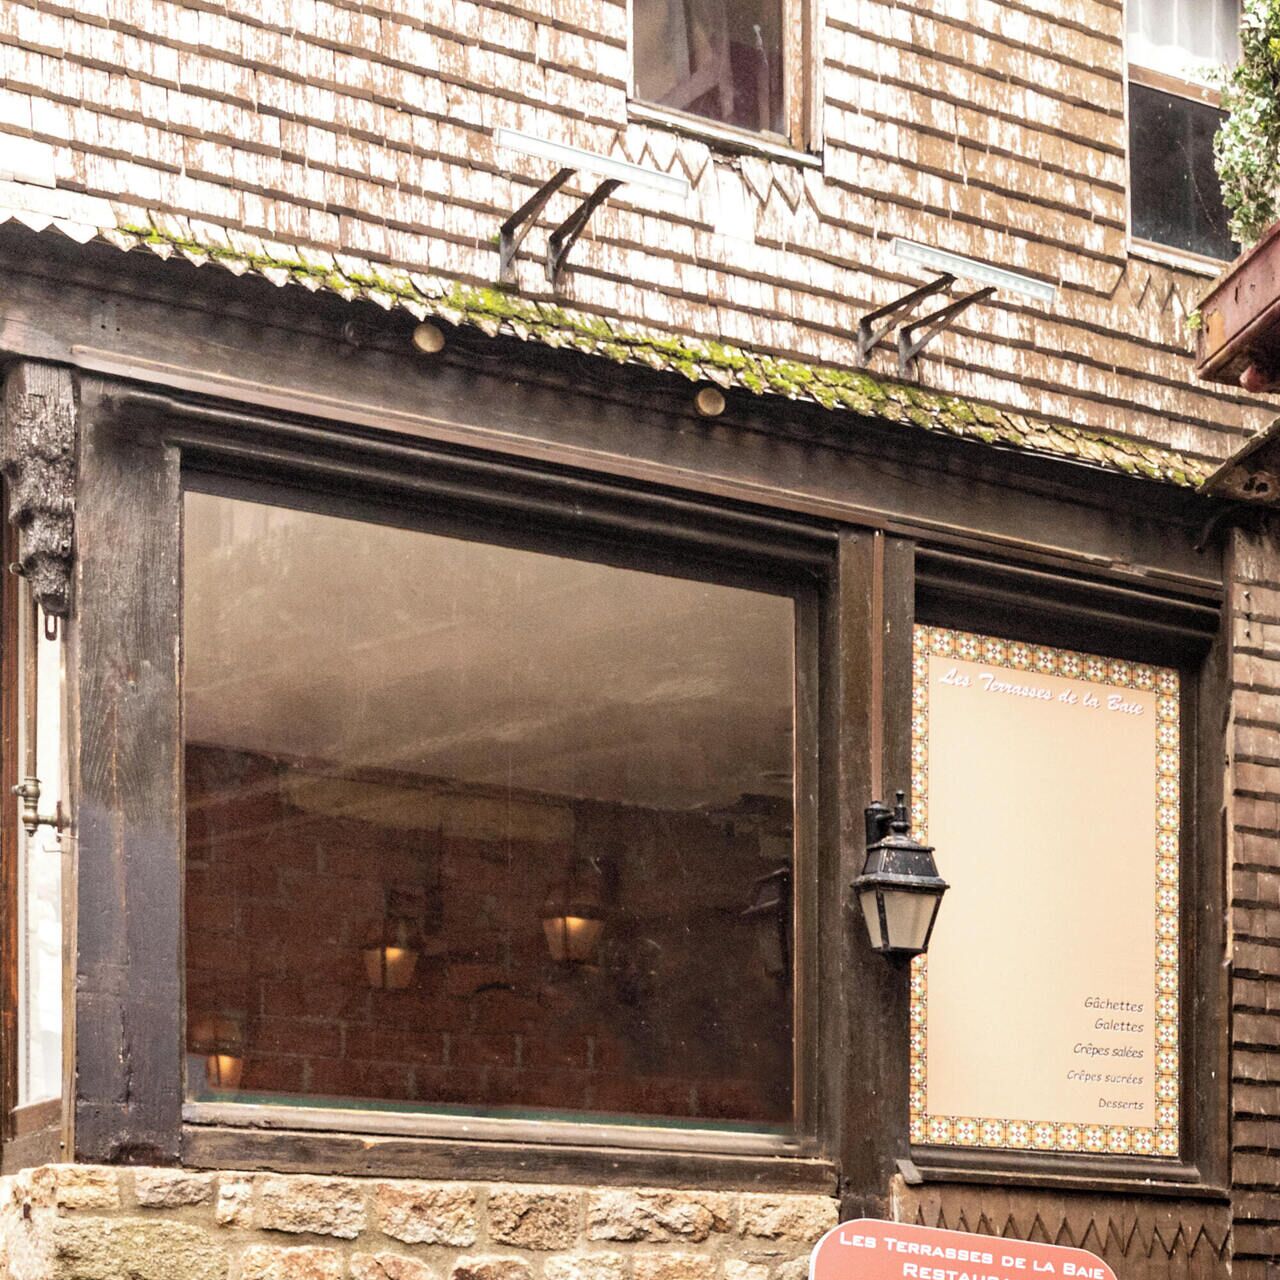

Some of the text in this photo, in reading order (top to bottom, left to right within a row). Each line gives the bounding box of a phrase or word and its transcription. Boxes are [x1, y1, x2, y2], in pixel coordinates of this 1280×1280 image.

[939, 667, 1143, 715] Les Terrasses de la Baie
[1094, 1018, 1144, 1033] Galettes
[1073, 1043, 1144, 1059] Crêpes salées
[1066, 1070, 1102, 1085] Crêpes
[1098, 1098, 1144, 1110] Desserts
[839, 1232, 1105, 1280] LES TERRASSES DE LA BAIE
